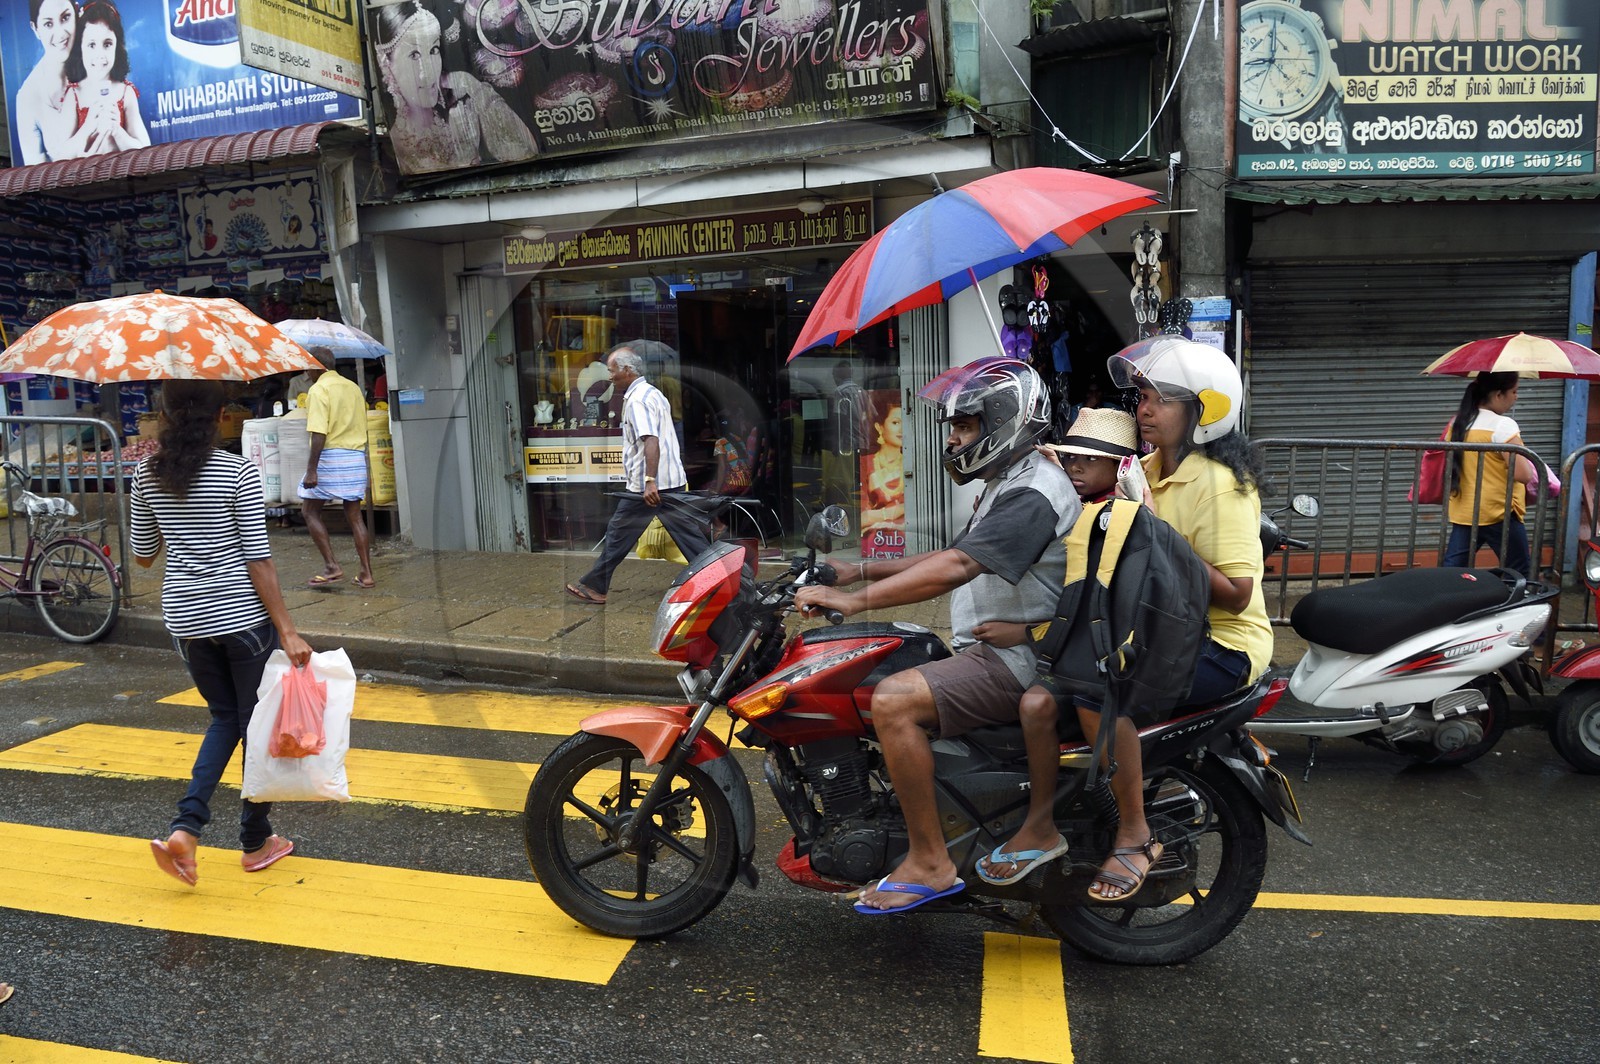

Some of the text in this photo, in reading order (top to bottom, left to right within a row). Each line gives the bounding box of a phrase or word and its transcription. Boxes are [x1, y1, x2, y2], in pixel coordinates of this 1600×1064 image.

[288, 7, 311, 22] money
[312, 15, 321, 25] for
[323, 20, 342, 32] better
[1341, 0, 1558, 43] NIMAL
[693, 2, 916, 98] Jewellers
[1369, 44, 1582, 73] WATCH WORK
[157, 75, 257, 115] MUHABBATH
[281, 97, 293, 107] Tel:
[294, 96, 307, 105] 054
[534, 96, 597, 133] සුභානි
[546, 136, 567, 147] No.
[567, 132, 586, 144] 04,
[709, 105, 794, 125] Nawalapitiya
[795, 101, 821, 115] Tel:
[1252, 114, 1583, 147] ඔරලෝසු අළුත්වැඩියා කරන්නෝ
[1481, 154, 1515, 169] 0716
[1554, 153, 1582, 167] 246
[637, 223, 689, 260] PAWNING
[692, 218, 735, 253] CENTER
[843, 206, 867, 241] இடம்
